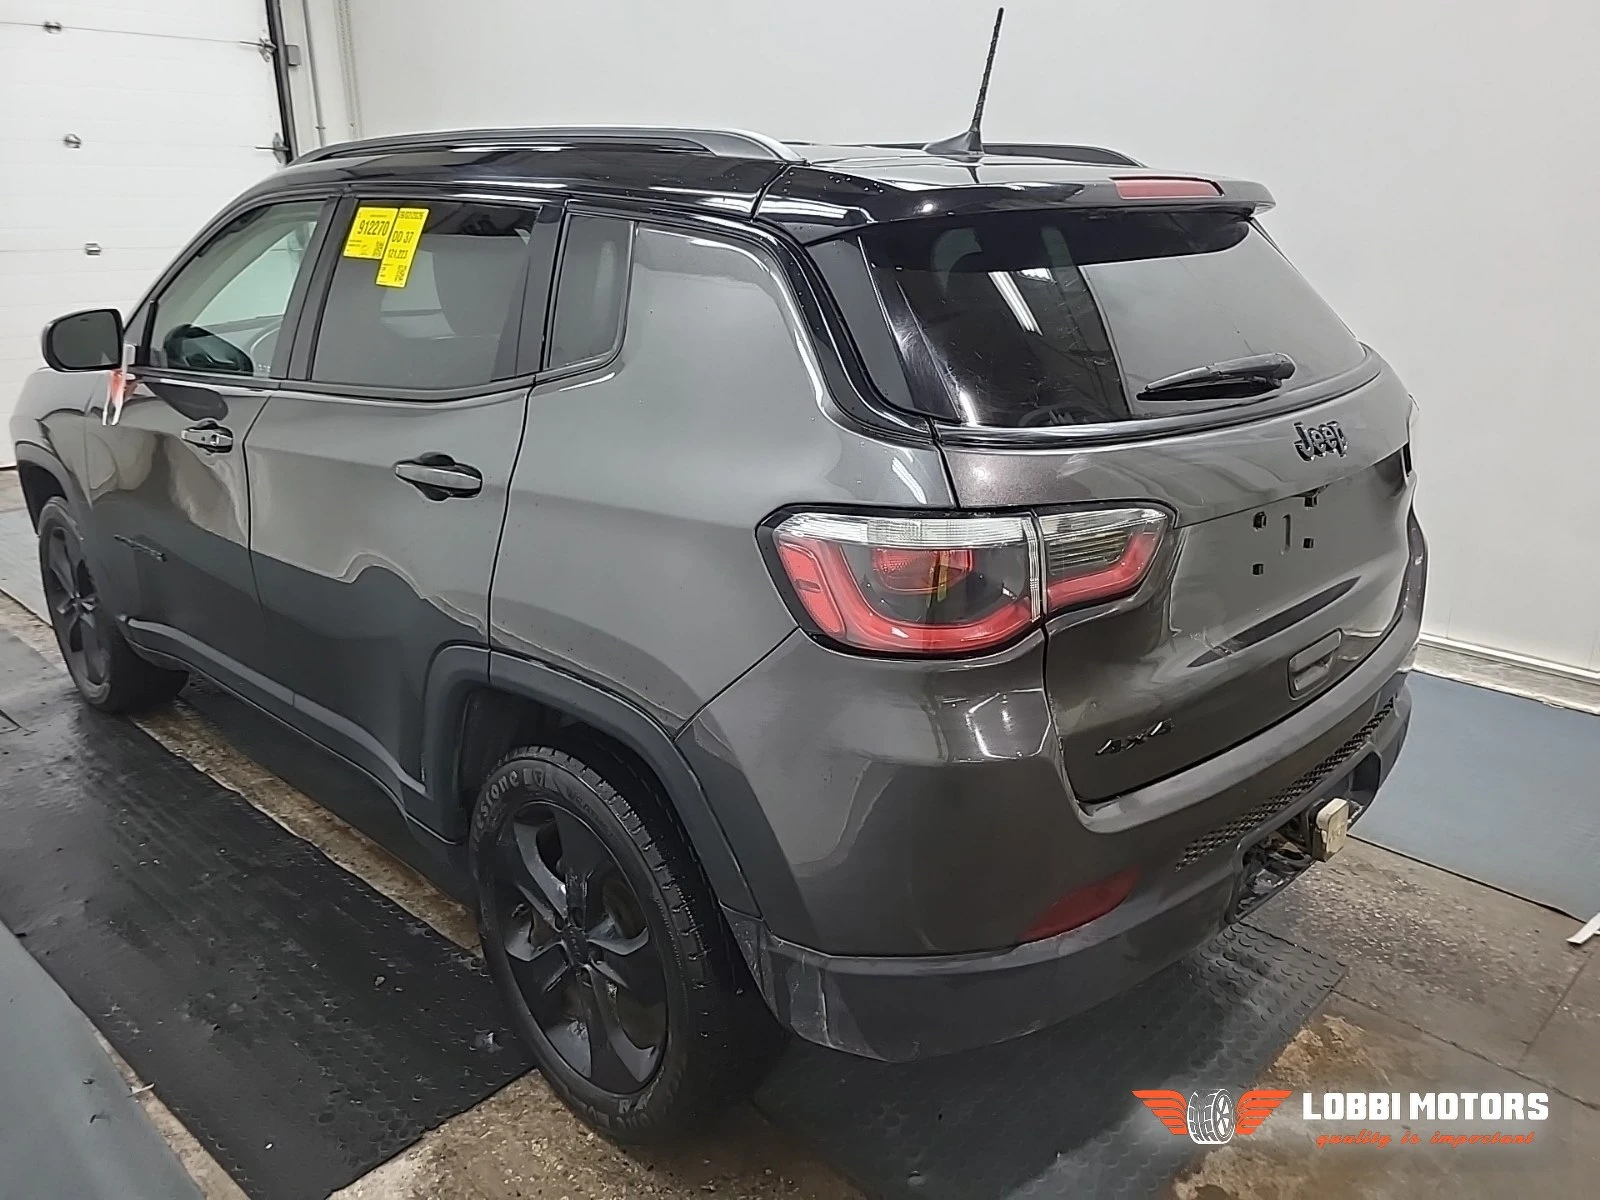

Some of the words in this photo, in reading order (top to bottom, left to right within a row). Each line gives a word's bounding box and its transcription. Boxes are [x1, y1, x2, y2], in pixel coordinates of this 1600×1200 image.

[357, 220, 390, 237] 912270
[391, 230, 404, 243] DD
[403, 231, 414, 244] 37
[1293, 420, 1347, 462] Jeep
